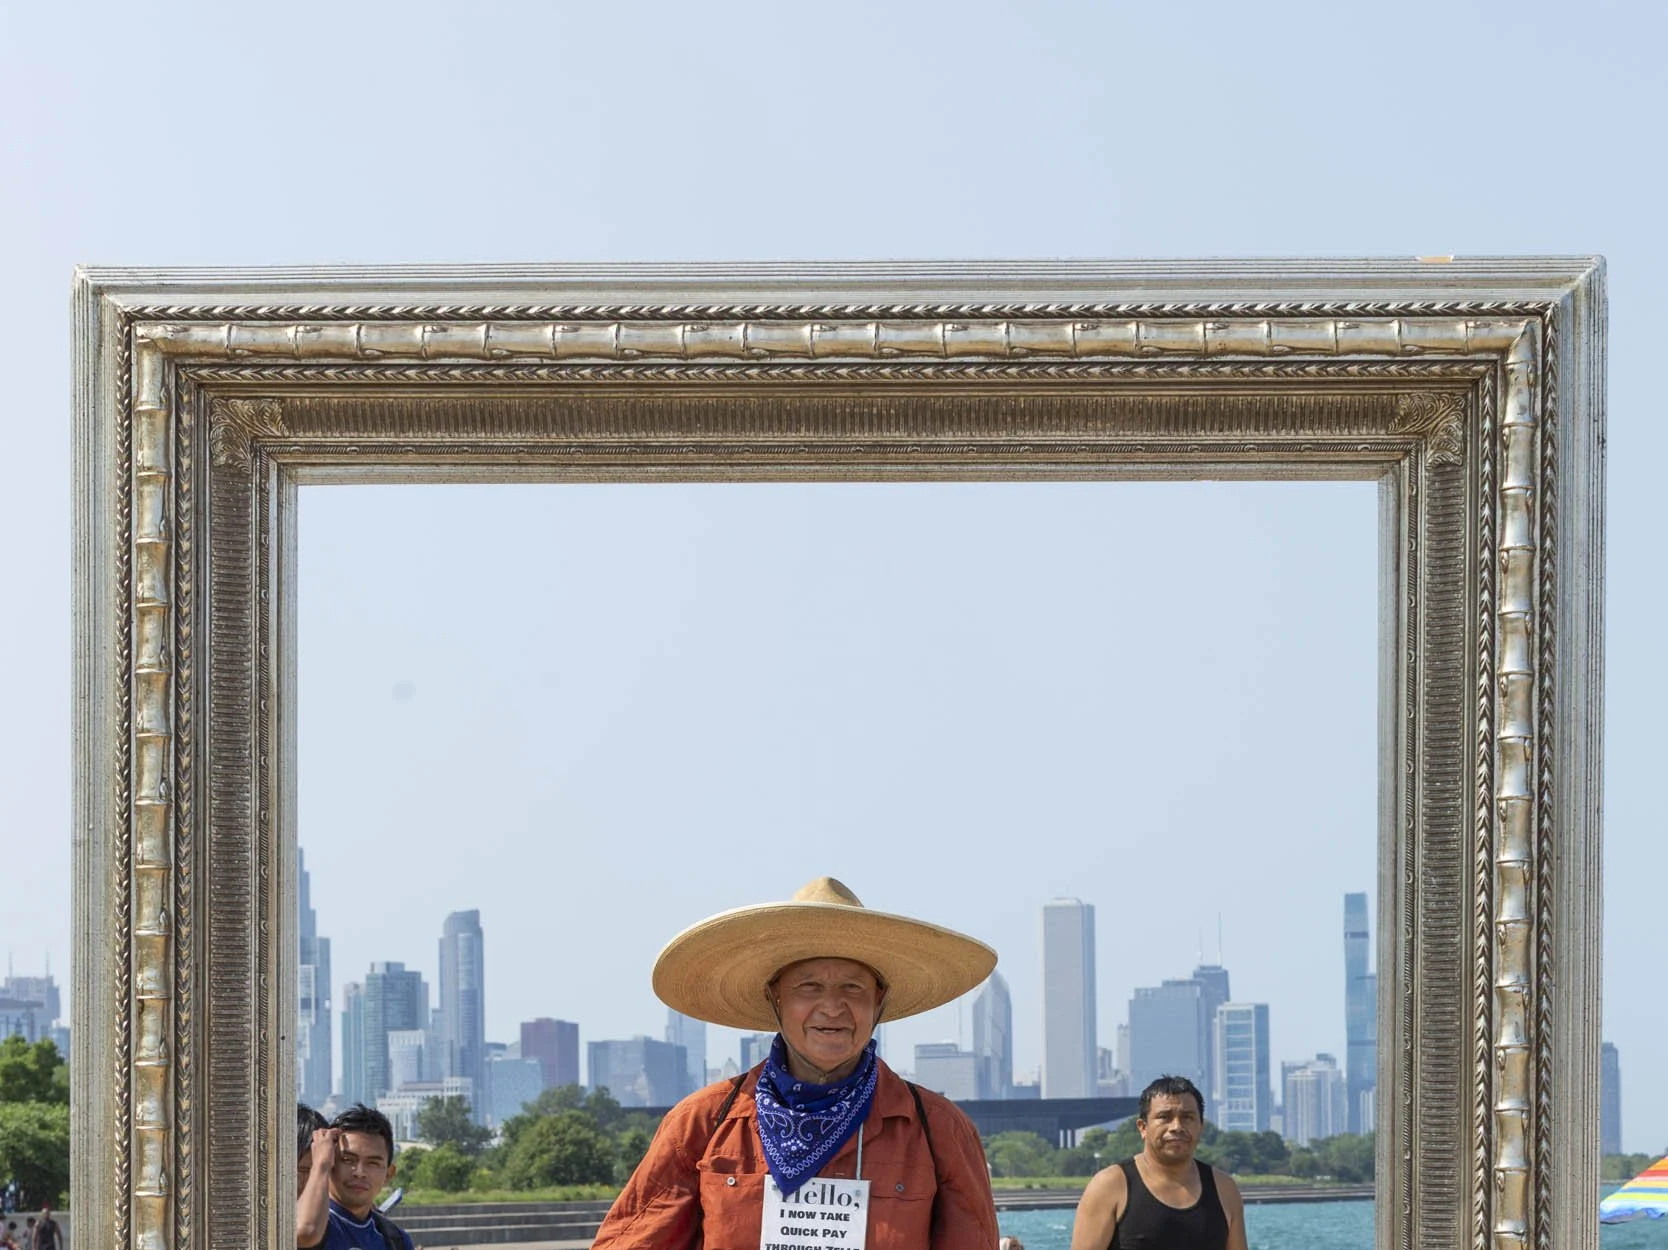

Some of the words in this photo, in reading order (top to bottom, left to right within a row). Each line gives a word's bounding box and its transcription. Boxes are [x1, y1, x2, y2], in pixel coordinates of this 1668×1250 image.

[780, 1209, 785, 1218] I
[788, 1210, 816, 1219] NOW
[820, 1211, 850, 1221] TAKE
[780, 1226, 819, 1237] QUICK
[822, 1229, 848, 1238] PAY
